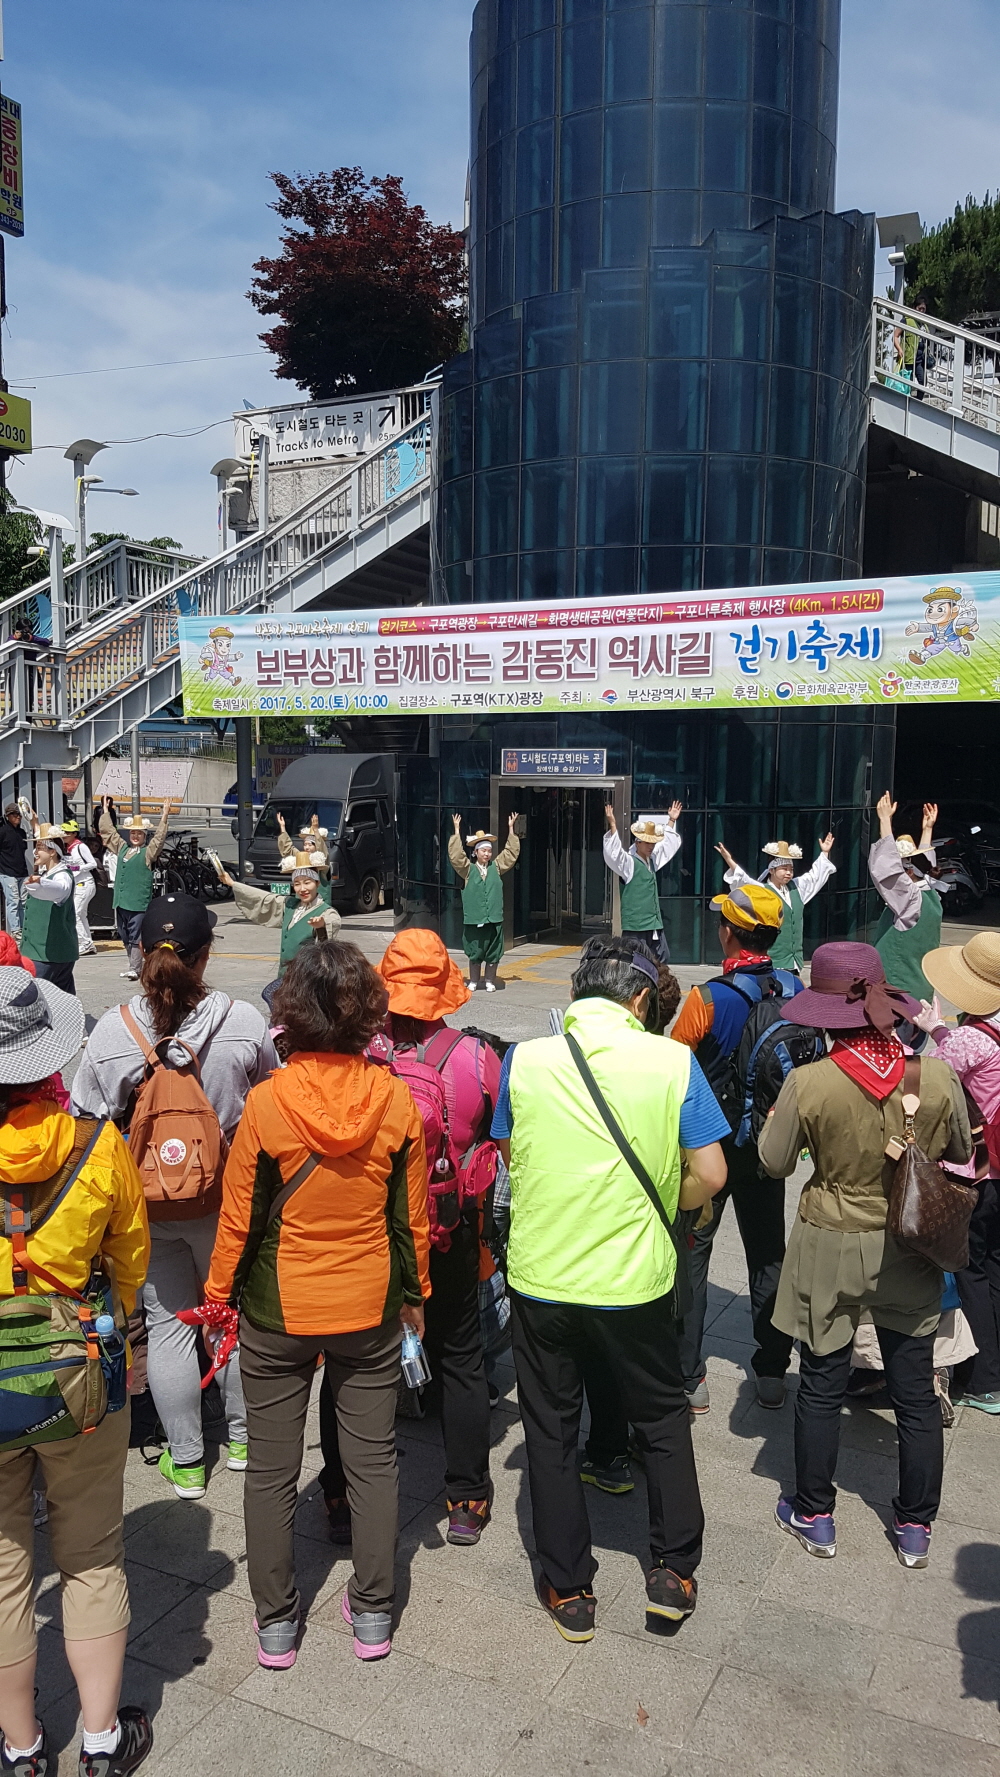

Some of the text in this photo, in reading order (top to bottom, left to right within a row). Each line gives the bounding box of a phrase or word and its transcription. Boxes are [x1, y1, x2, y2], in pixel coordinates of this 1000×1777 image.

[1, 114, 18, 192] 중장비
[0, 187, 22, 210] 학원
[275, 411, 364, 434] 도시철도 타는 곳
[276, 434, 359, 453] Tracks to Metro
[381, 619, 417, 633] 걷기코스
[429, 616, 478, 632] 구포역광장
[487, 614, 538, 629] 구포만세길
[674, 601, 745, 620] 구포나루축제
[749, 598, 786, 616] 행사장
[831, 591, 880, 611] 1.5시간)
[286, 617, 343, 639] 구포나루축제
[256, 619, 880, 686] 보부상과 함께하는 감동진 역사길 걷기축제
[733, 685, 759, 699] 후원
[797, 682, 868, 695] 문화체육관광부
[905, 679, 958, 689] 한국관광공사
[213, 698, 249, 711] 축제일시
[354, 694, 388, 708] 10:00
[398, 695, 438, 708] 집결장소
[450, 691, 543, 707] 구포역(KTX)광장
[560, 691, 582, 704] 주최
[627, 687, 715, 703] 부산광역시 북구
[593, 753, 600, 765] 곳
[26, 1415, 58, 1434] Lafuma
